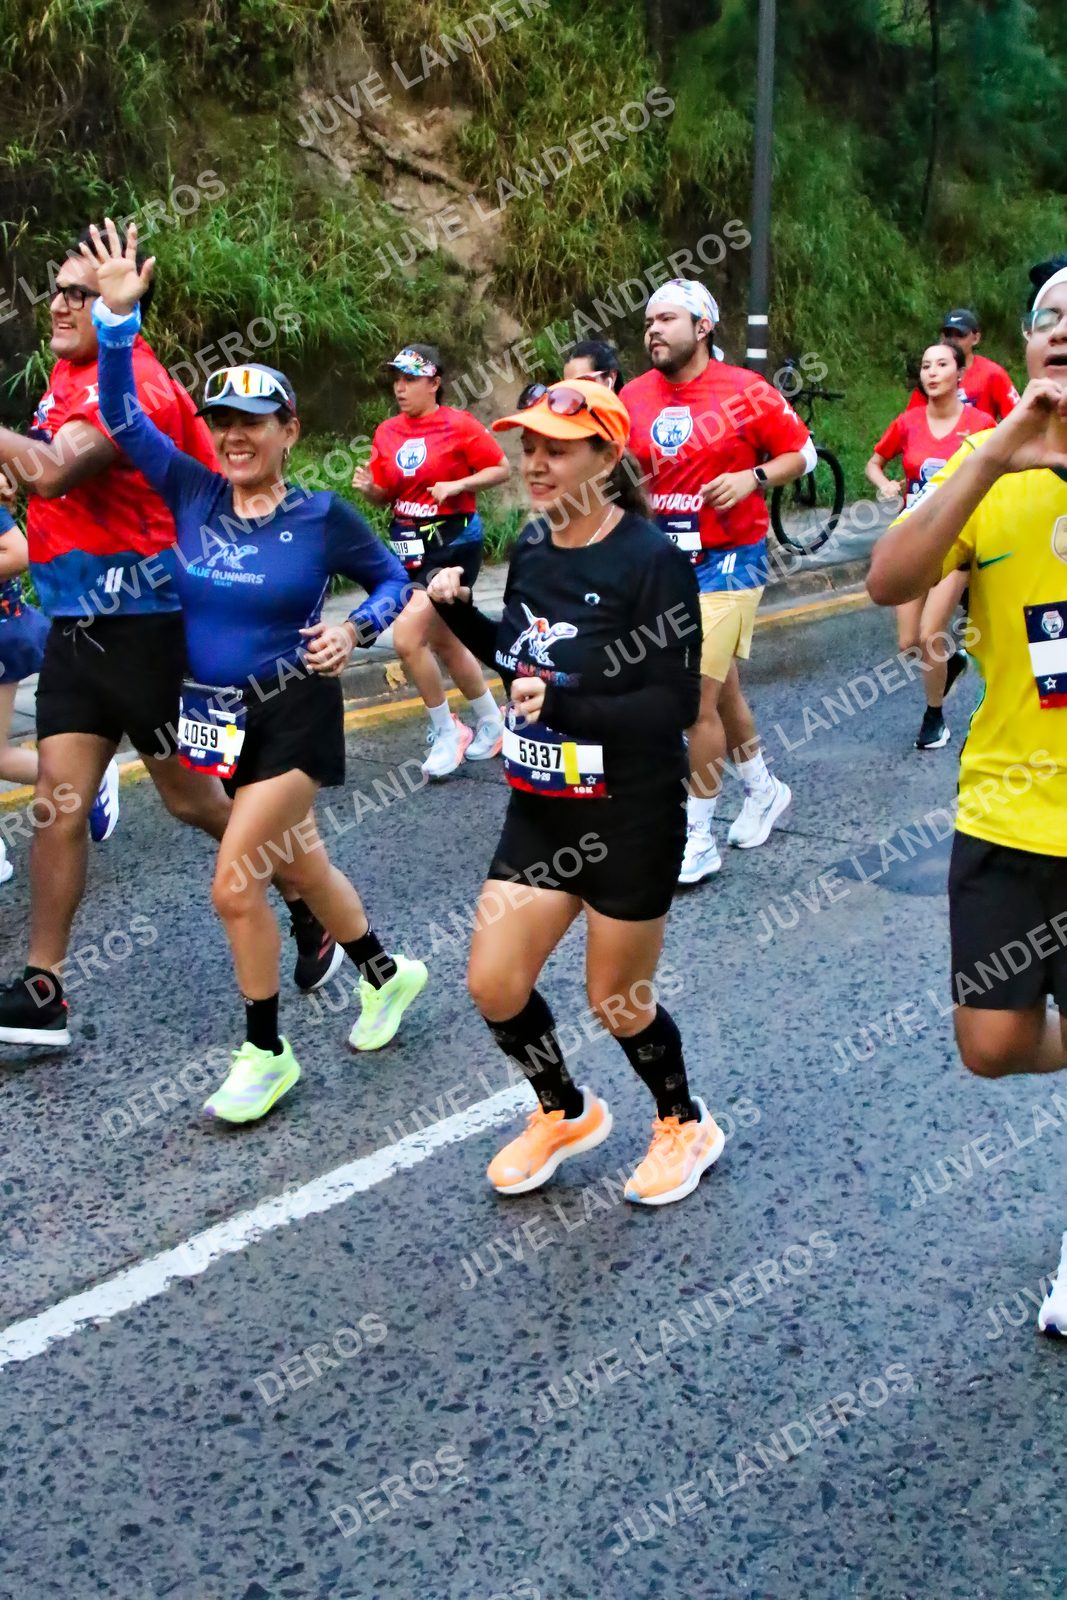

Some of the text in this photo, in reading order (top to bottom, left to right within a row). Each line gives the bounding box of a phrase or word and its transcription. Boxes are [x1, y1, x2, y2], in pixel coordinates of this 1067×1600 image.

[212, 569, 266, 584] RUNNERS
[495, 650, 518, 671] BLUE
[184, 723, 218, 748] 4059
[519, 739, 562, 769] 5337
